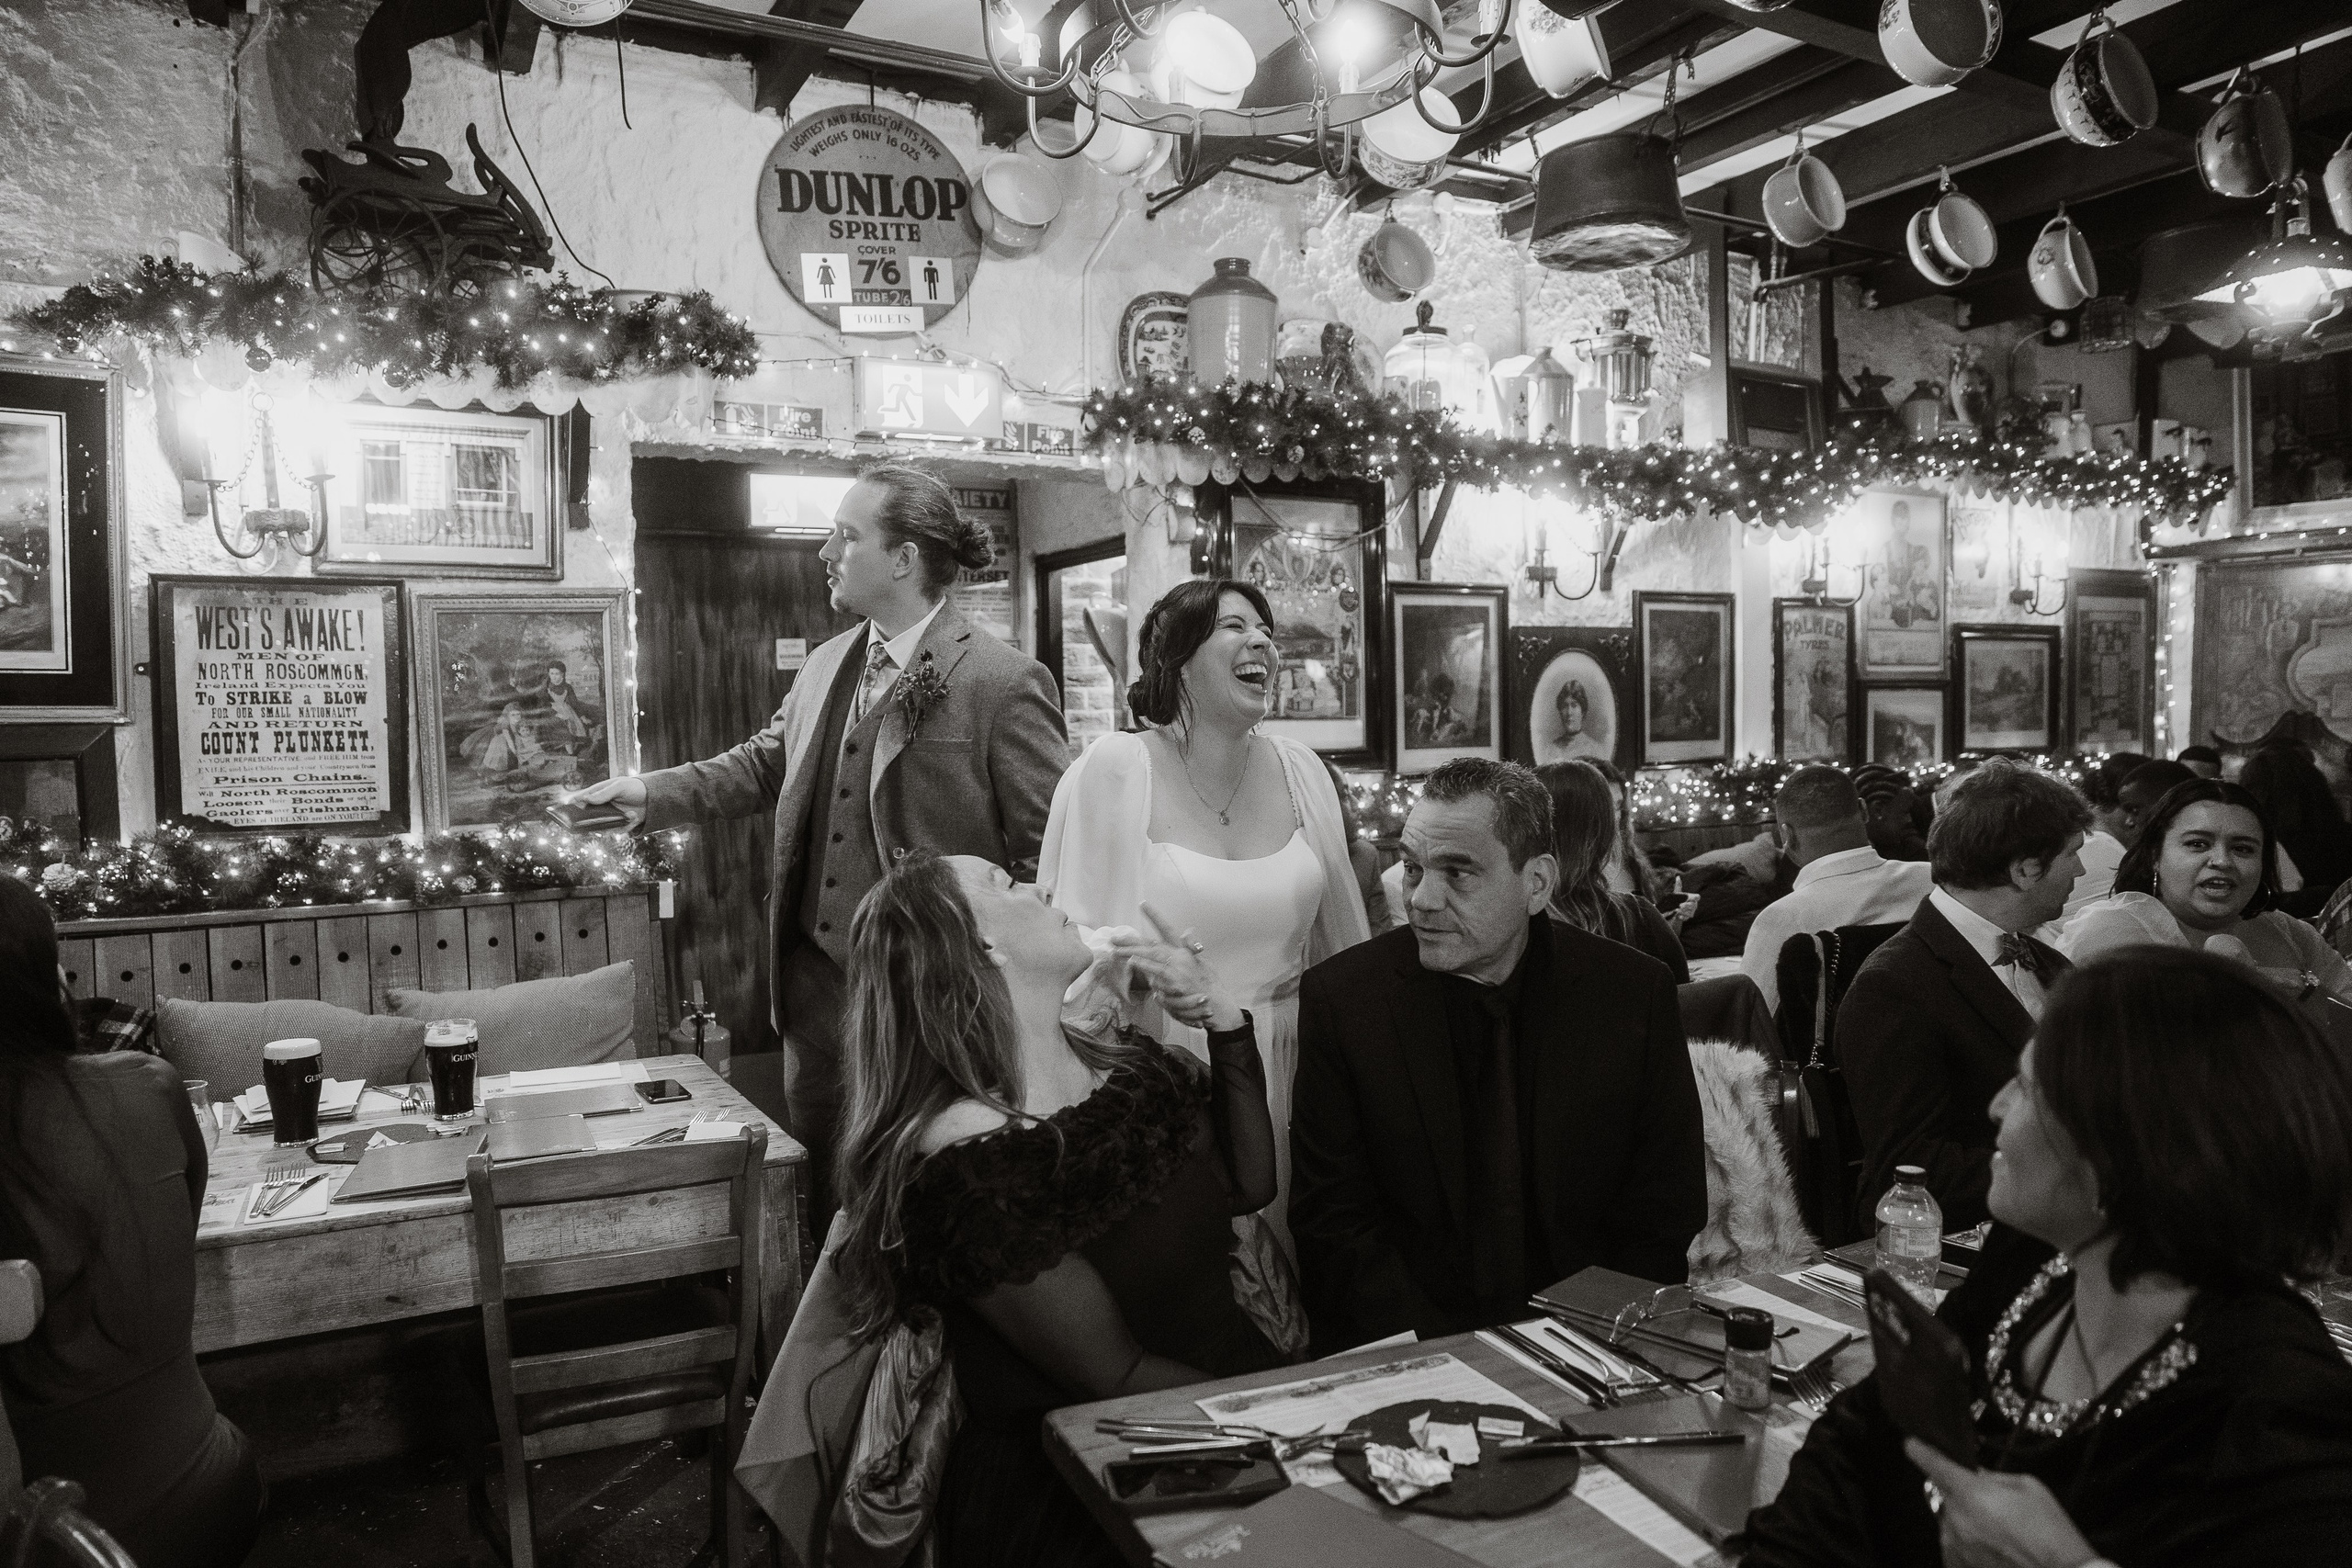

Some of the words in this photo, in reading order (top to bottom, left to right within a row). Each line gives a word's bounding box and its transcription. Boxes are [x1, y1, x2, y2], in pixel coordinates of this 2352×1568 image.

[789, 119, 826, 152] LIGHTEST
[827, 113, 847, 129] AND
[850, 111, 888, 128] FASTEST
[889, 119, 903, 132] OF
[903, 126, 919, 141] ITS
[919, 136, 942, 161] TYPE
[808, 130, 849, 158] WEIGHS
[852, 129, 882, 141] ONLY
[886, 134, 899, 148] 16
[899, 141, 922, 162] OZS
[774, 167, 967, 221] DUNLOP
[829, 219, 922, 243] SPRITE
[856, 245, 897, 254] COVER
[853, 291, 889, 303] TUBE
[889, 290, 910, 306] 2/6
[854, 313, 911, 324] TOILETS
[778, 407, 812, 423] Fire
[773, 423, 818, 439] Point
[1036, 425, 1066, 441] Fire
[1031, 439, 1070, 456] Point
[252, 597, 308, 605] THE
[195, 605, 273, 650] WEST'S
[284, 607, 365, 651] AWAKE!
[237, 652, 288, 660] MEN
[295, 653, 325, 661] OF
[198, 662, 254, 680] NORTH
[265, 682, 331, 690] Expects
[195, 691, 215, 706] To
[226, 691, 293, 705] STRIKE
[303, 694, 312, 705] a
[323, 691, 368, 705] BLOW
[211, 707, 229, 718] FOR
[236, 706, 254, 718] OUR
[261, 706, 291, 718] SMALL
[298, 706, 357, 718] NATIONALITY
[208, 720, 259, 729] AND
[265, 719, 363, 728] RETURN
[200, 730, 259, 755] COUNT
[273, 729, 374, 753] PLUNKETT,
[213, 775, 283, 784] Prison
[293, 773, 368, 783] Chains.
[220, 789, 271, 797] North
[276, 786, 378, 795] Roscommon
[203, 800, 264, 808] Loosen
[291, 795, 345, 804] Bonds
[205, 808, 273, 818] Gaolers
[291, 805, 374, 814] Irishmen.
